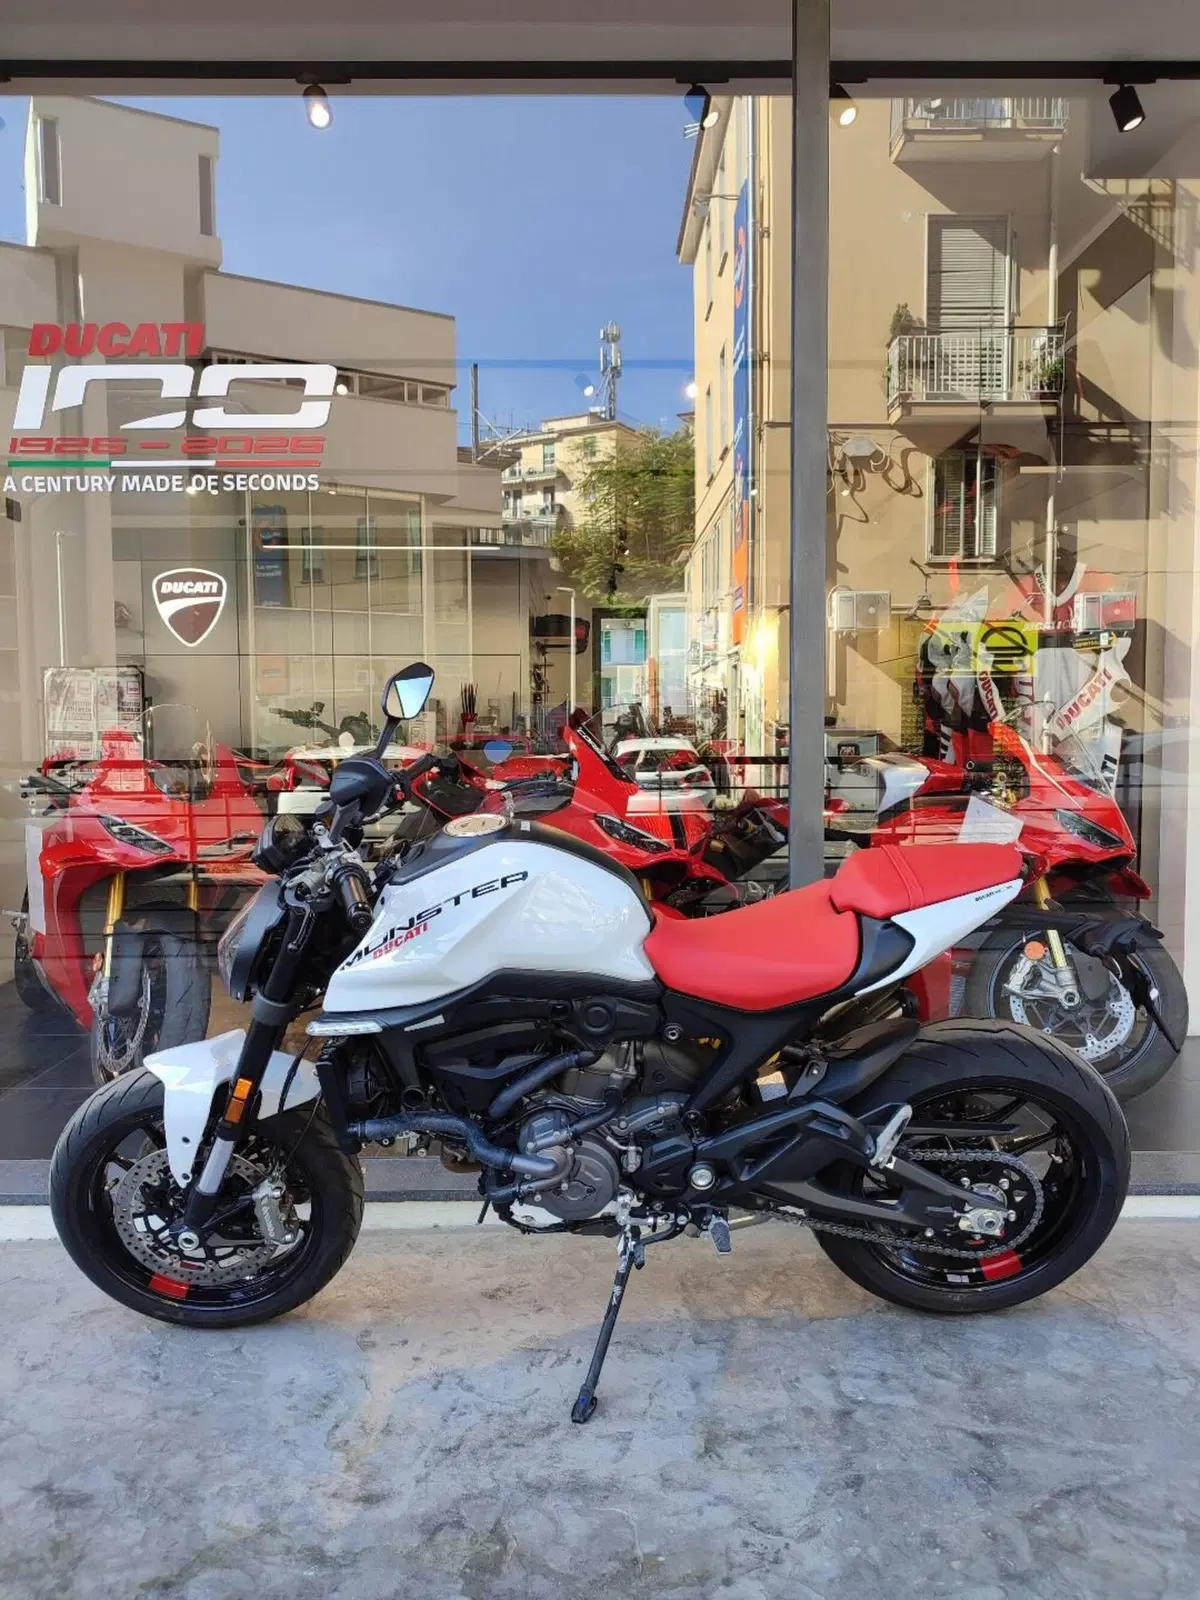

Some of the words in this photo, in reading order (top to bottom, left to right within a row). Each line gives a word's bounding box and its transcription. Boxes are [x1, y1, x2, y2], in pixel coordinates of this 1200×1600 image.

[28, 323, 206, 357] DUCATI
[8, 437, 128, 454] 1926
[181, 435, 326, 454] 2026
[2, 475, 17, 492] A
[21, 475, 116, 492] CENTURY
[121, 475, 183, 492] MADE
[191, 474, 218, 492] OF
[222, 473, 319, 491] SECONDS
[160, 581, 218, 594] DUCATI
[979, 671, 998, 720] DUCATI
[1055, 667, 1112, 730] DUCATI
[340, 870, 529, 972] MONSTER
[372, 921, 429, 960] DUCATI
